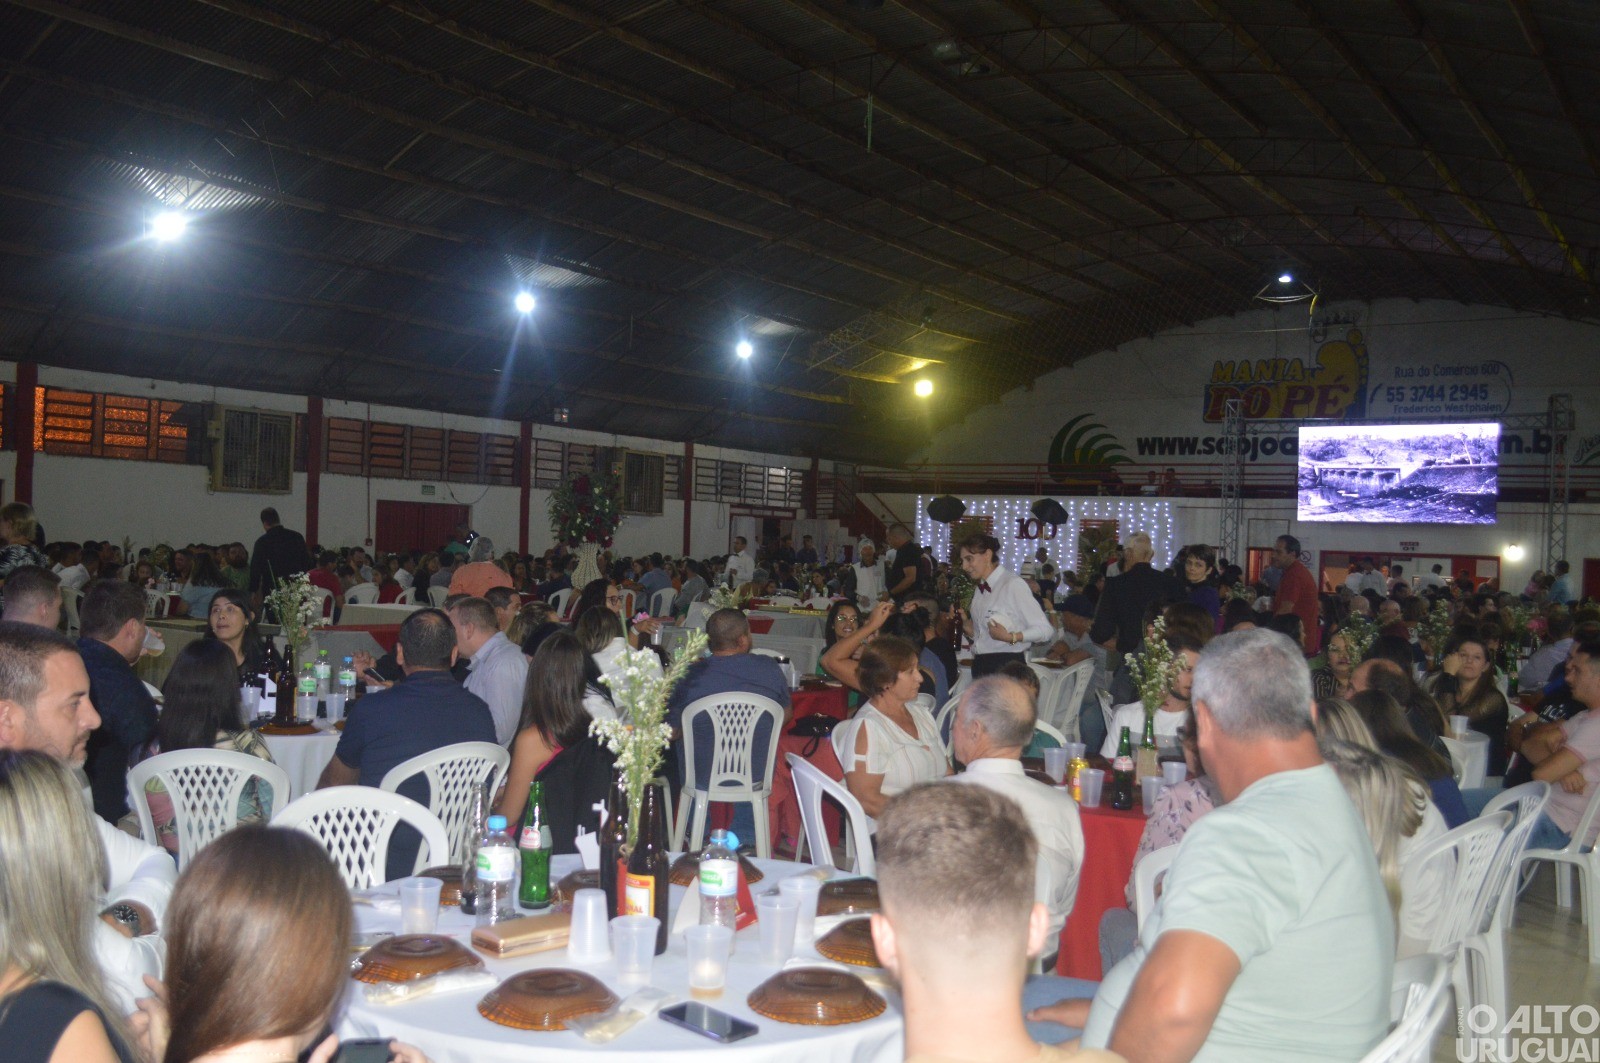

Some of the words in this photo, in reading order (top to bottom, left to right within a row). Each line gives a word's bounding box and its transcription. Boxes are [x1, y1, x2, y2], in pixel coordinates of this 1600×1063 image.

[1210, 358, 1304, 383] MANIA
[1394, 366, 1414, 378] Rua
[1417, 365, 1430, 377] do
[1279, 374, 1349, 419] PÉ
[1386, 386, 1405, 402] 55
[1409, 384, 1445, 401] 3744
[1449, 383, 1489, 400] 2945
